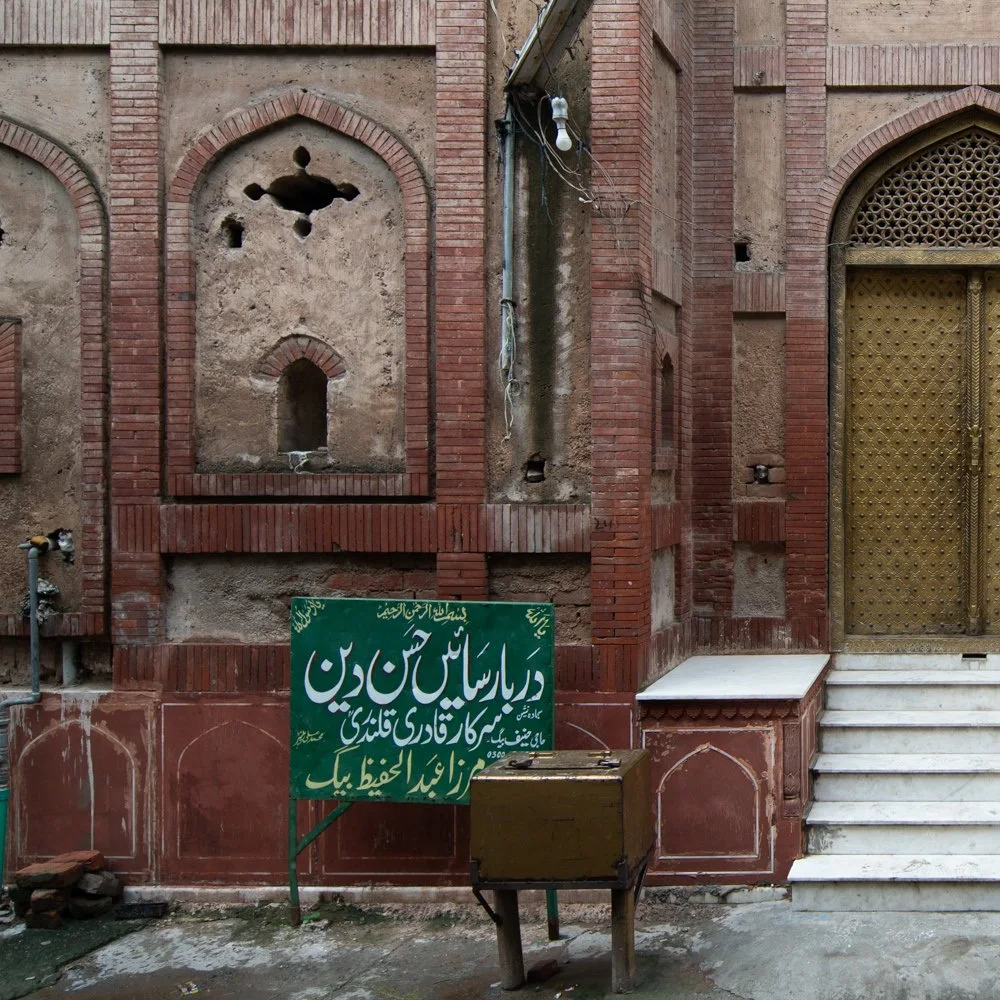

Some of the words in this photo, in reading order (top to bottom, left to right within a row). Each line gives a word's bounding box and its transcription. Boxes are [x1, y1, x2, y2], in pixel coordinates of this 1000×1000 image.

[304, 642, 364, 713] دین
[393, 706, 454, 746] قادری
[446, 707, 503, 752] سرکار
[305, 745, 360, 797] بیگ
[446, 749, 486, 800] مرزا
